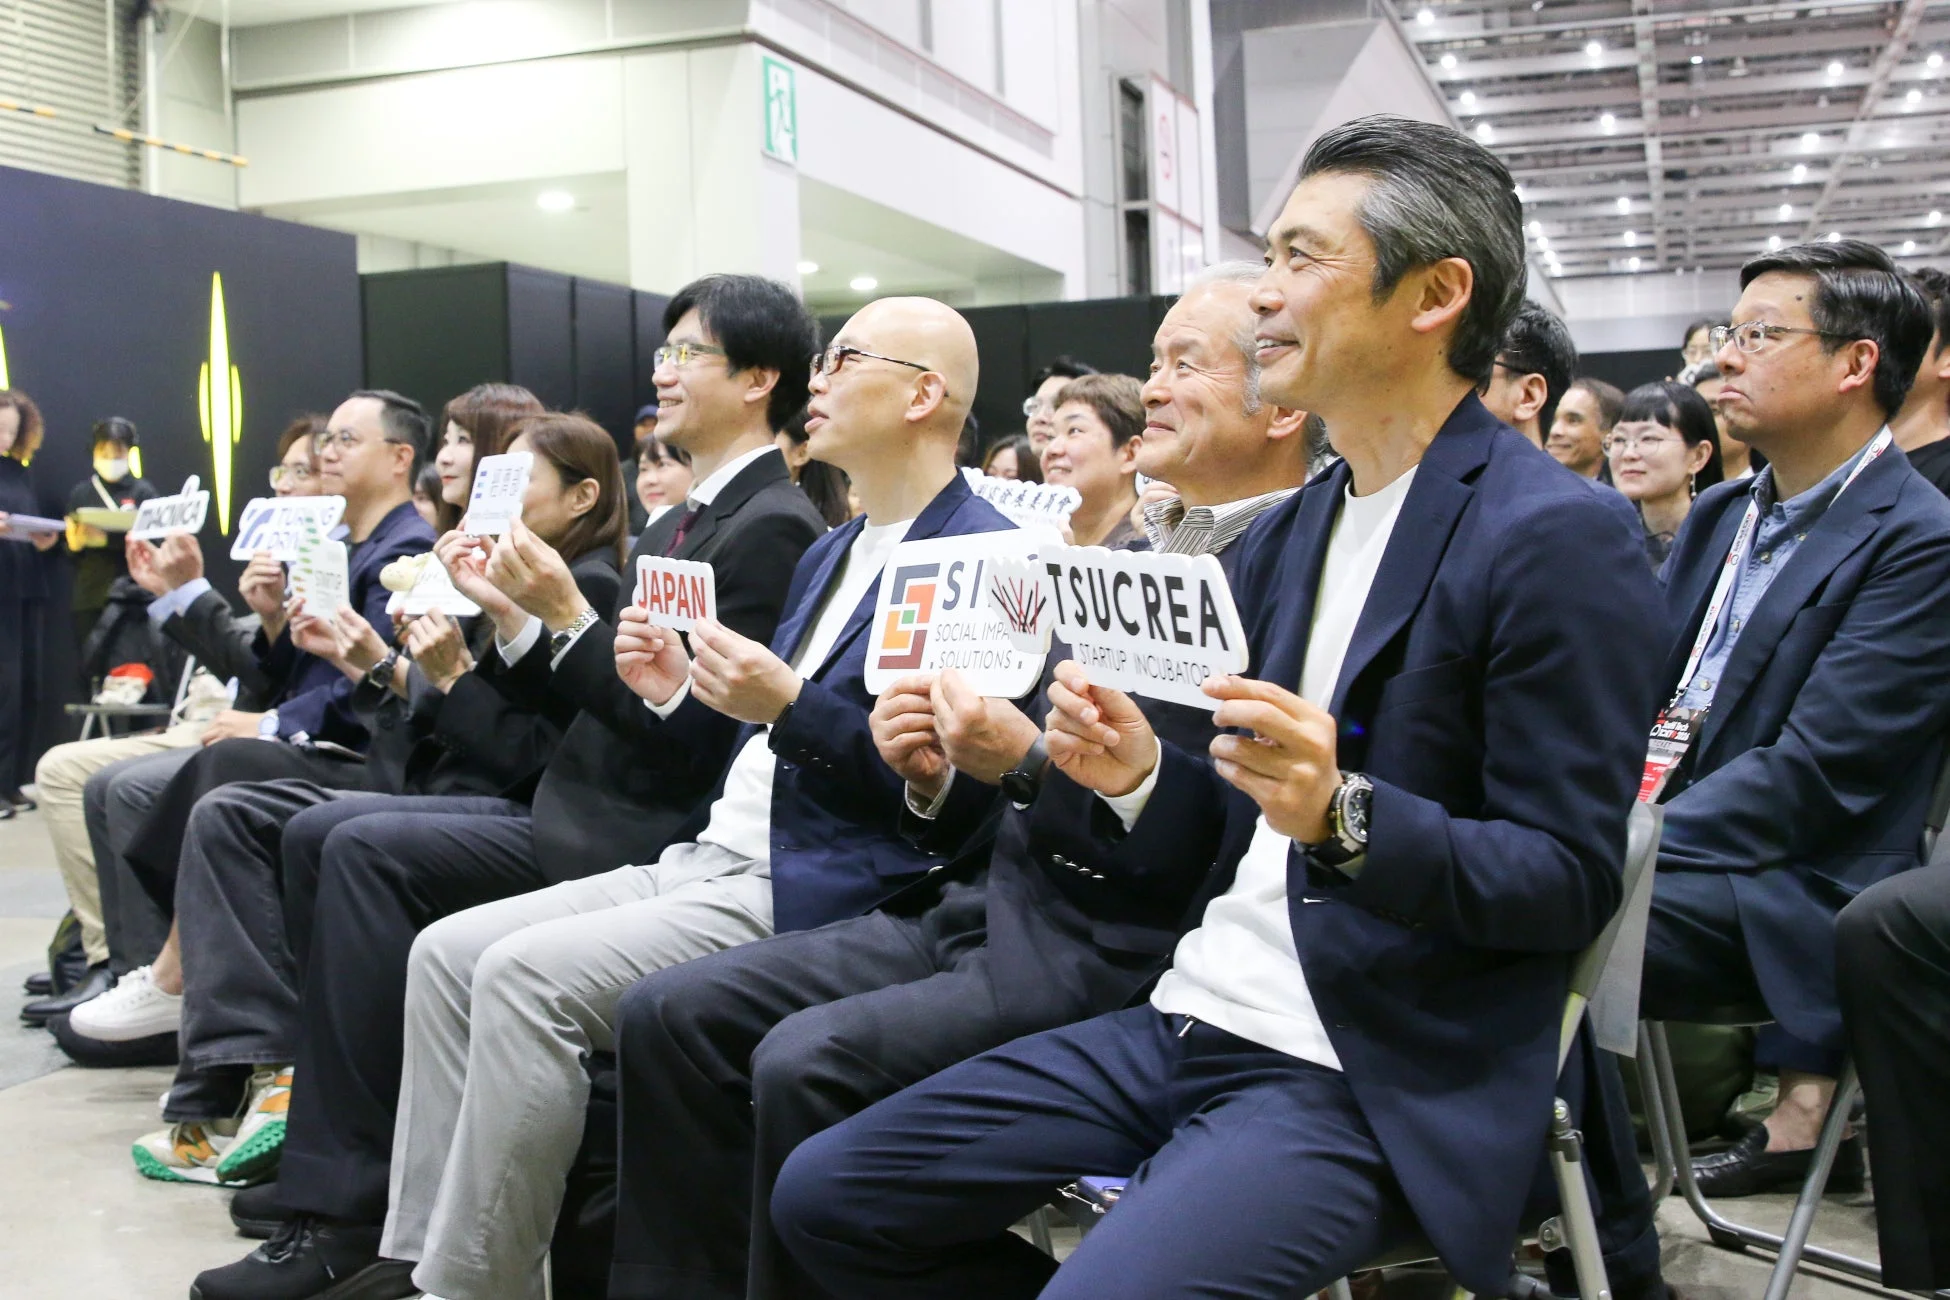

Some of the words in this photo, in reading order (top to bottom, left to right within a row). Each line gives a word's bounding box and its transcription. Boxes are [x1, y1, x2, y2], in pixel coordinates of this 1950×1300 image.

[638, 568, 707, 620] JAPAN
[1045, 562, 1229, 652] TSUCREA
[935, 624, 978, 642] SOCIAL
[981, 623, 1010, 638] IMPA
[938, 650, 1013, 670] SOLUTIONS
[1079, 642, 1127, 672] STARTUP
